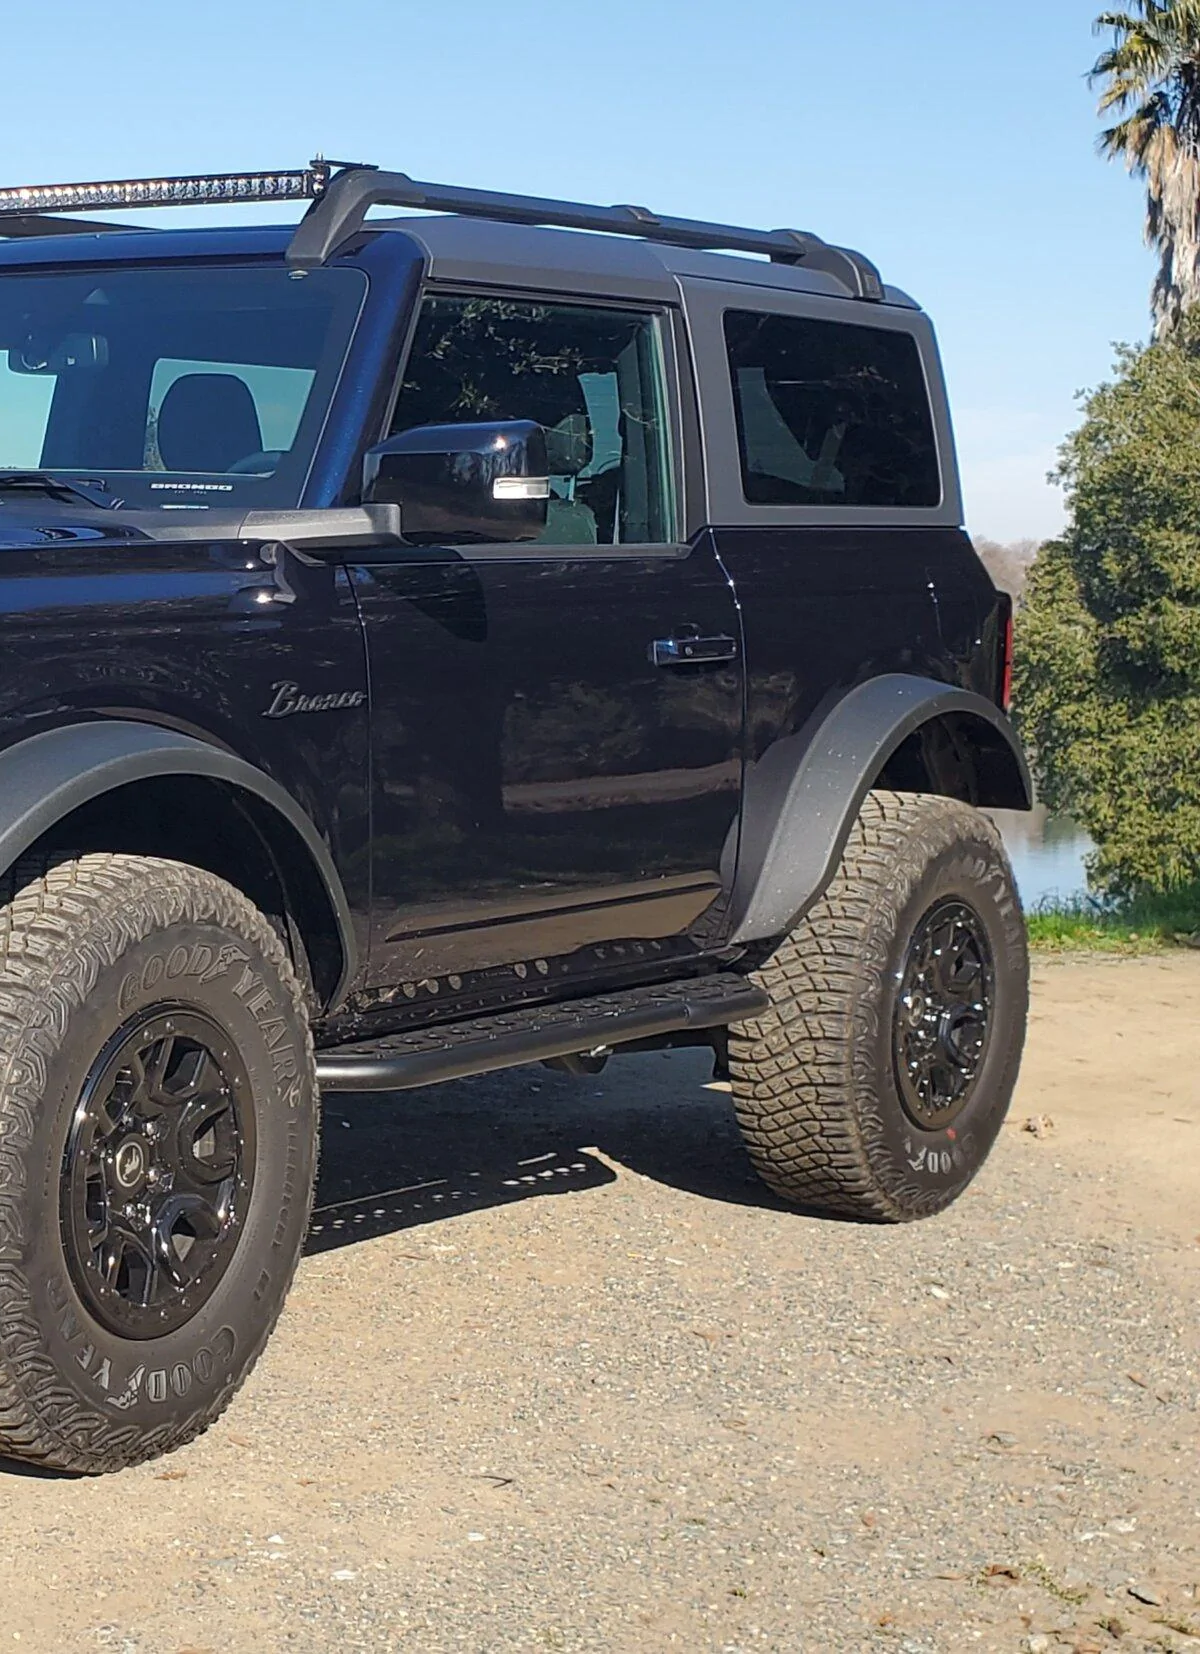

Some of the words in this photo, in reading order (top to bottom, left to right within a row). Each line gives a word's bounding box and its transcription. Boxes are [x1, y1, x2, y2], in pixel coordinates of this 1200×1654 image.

[261, 680, 367, 718] Bronco
[932, 857, 1022, 971] OODYEAR
[118, 942, 300, 1087] GOODYEAR
